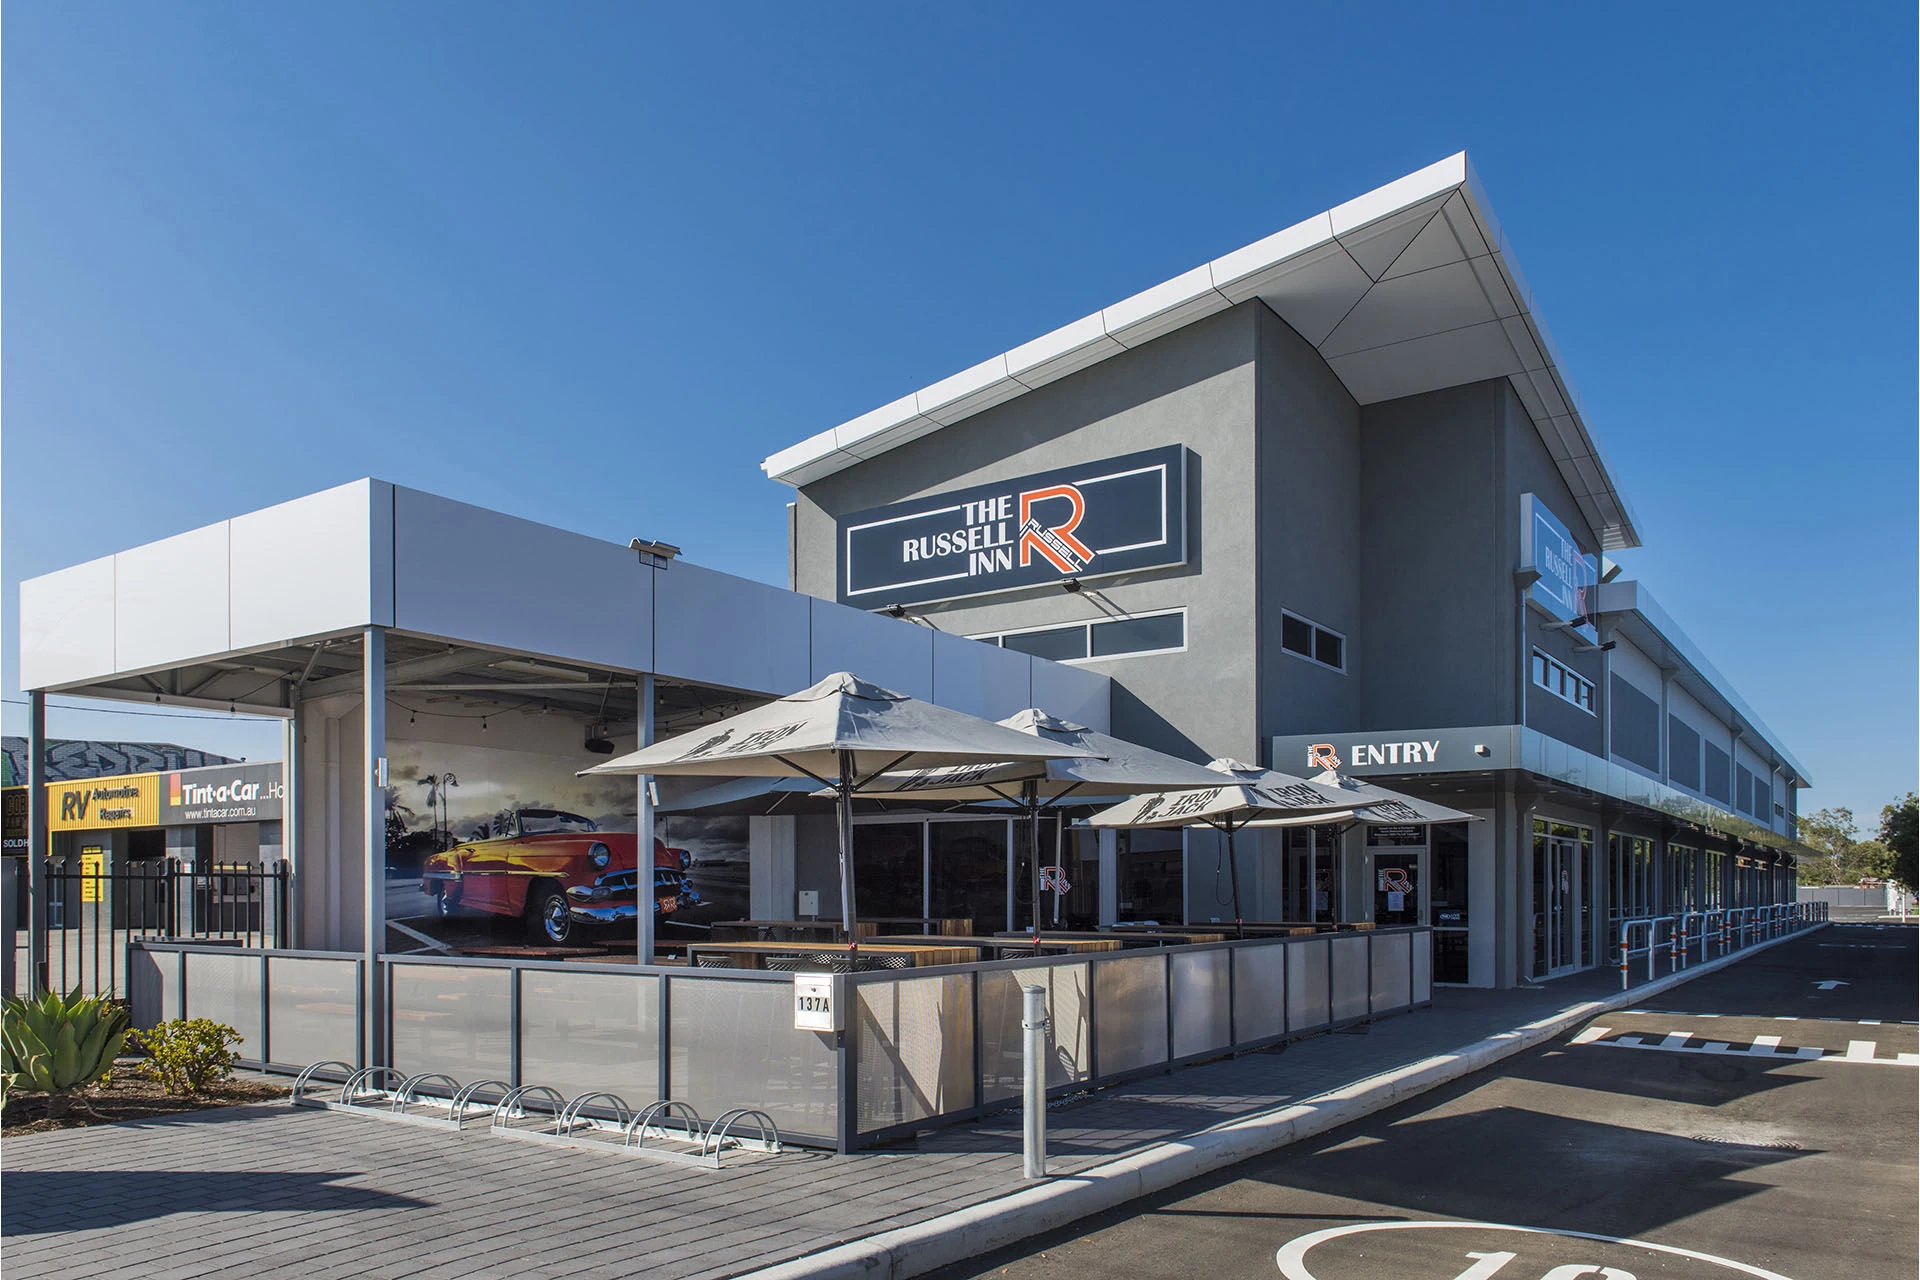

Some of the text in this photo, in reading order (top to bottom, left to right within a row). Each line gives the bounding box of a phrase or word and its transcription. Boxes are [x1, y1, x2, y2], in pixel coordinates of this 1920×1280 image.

[962, 495, 1013, 526] THE
[903, 522, 1014, 563] RUSSELL
[1027, 517, 1083, 572] RUSSELL
[1561, 539, 1572, 567] THE
[969, 547, 1013, 577] INN
[1545, 545, 1573, 589] RUSSELL
[1352, 741, 1440, 766] ENTRY
[62, 786, 140, 820] RV Automotive
[1171, 787, 1222, 806] IRON
[1266, 783, 1318, 798] IRON
[1285, 794, 1336, 806] JACK
[100, 808, 134, 822] Repairs
[184, 807, 256, 819] www.tintacar.com.au
[1158, 800, 1212, 817] JACK
[799, 996, 829, 1012] 137A
